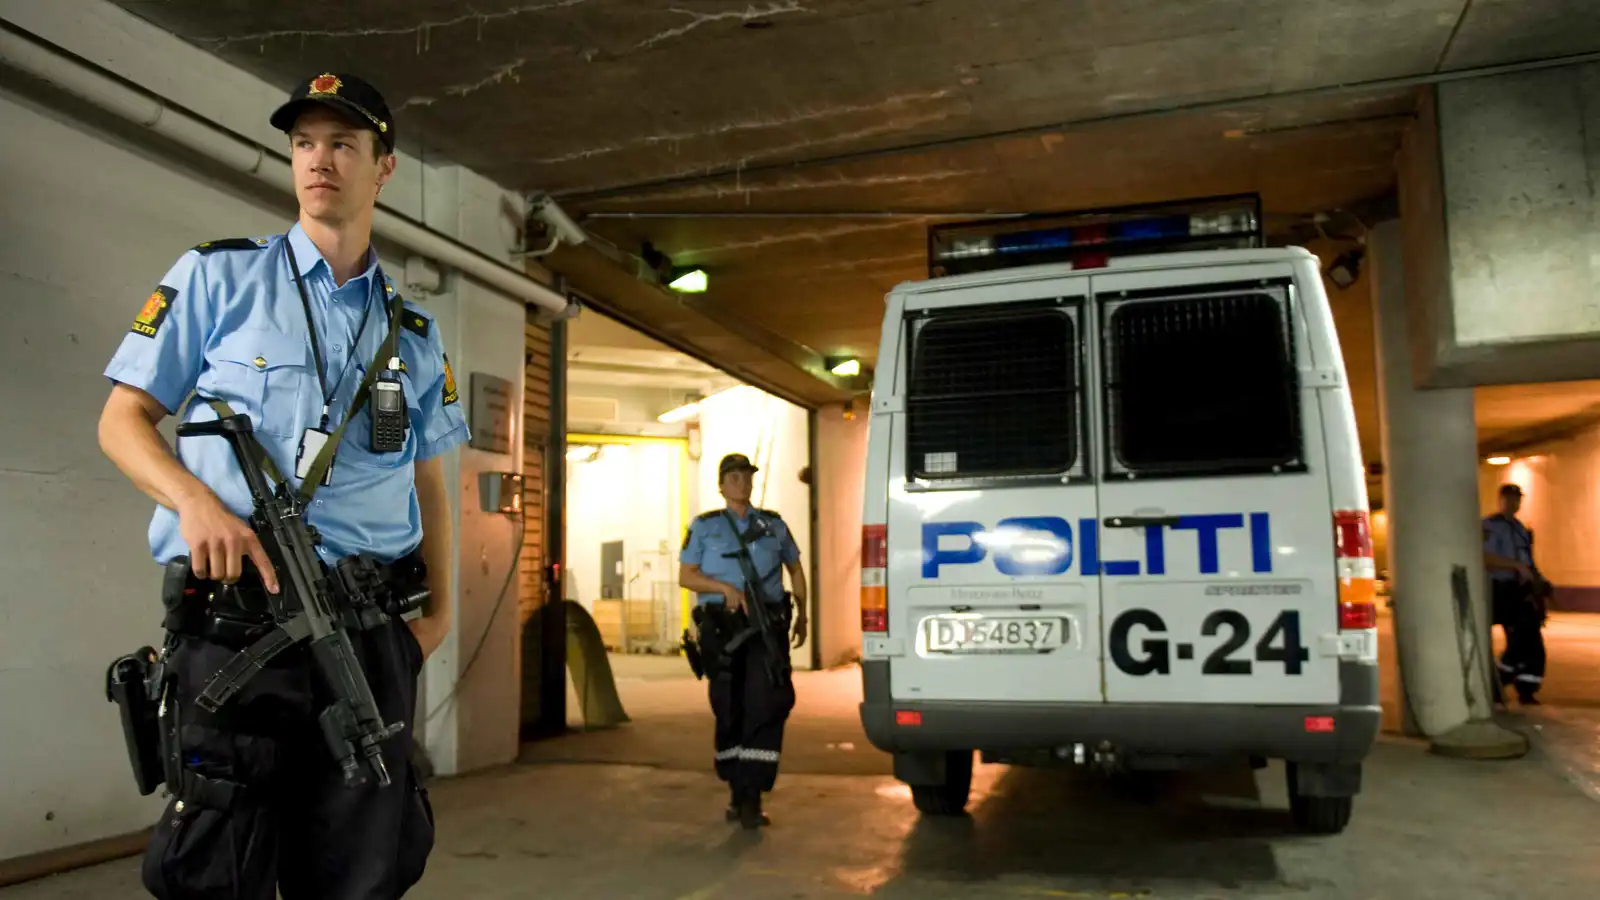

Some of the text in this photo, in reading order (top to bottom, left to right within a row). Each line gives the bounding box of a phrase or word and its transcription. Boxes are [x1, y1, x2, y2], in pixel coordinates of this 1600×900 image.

[131, 322, 156, 335] OLITI
[922, 512, 1272, 578] POLITI
[1109, 608, 1309, 676] G-24
